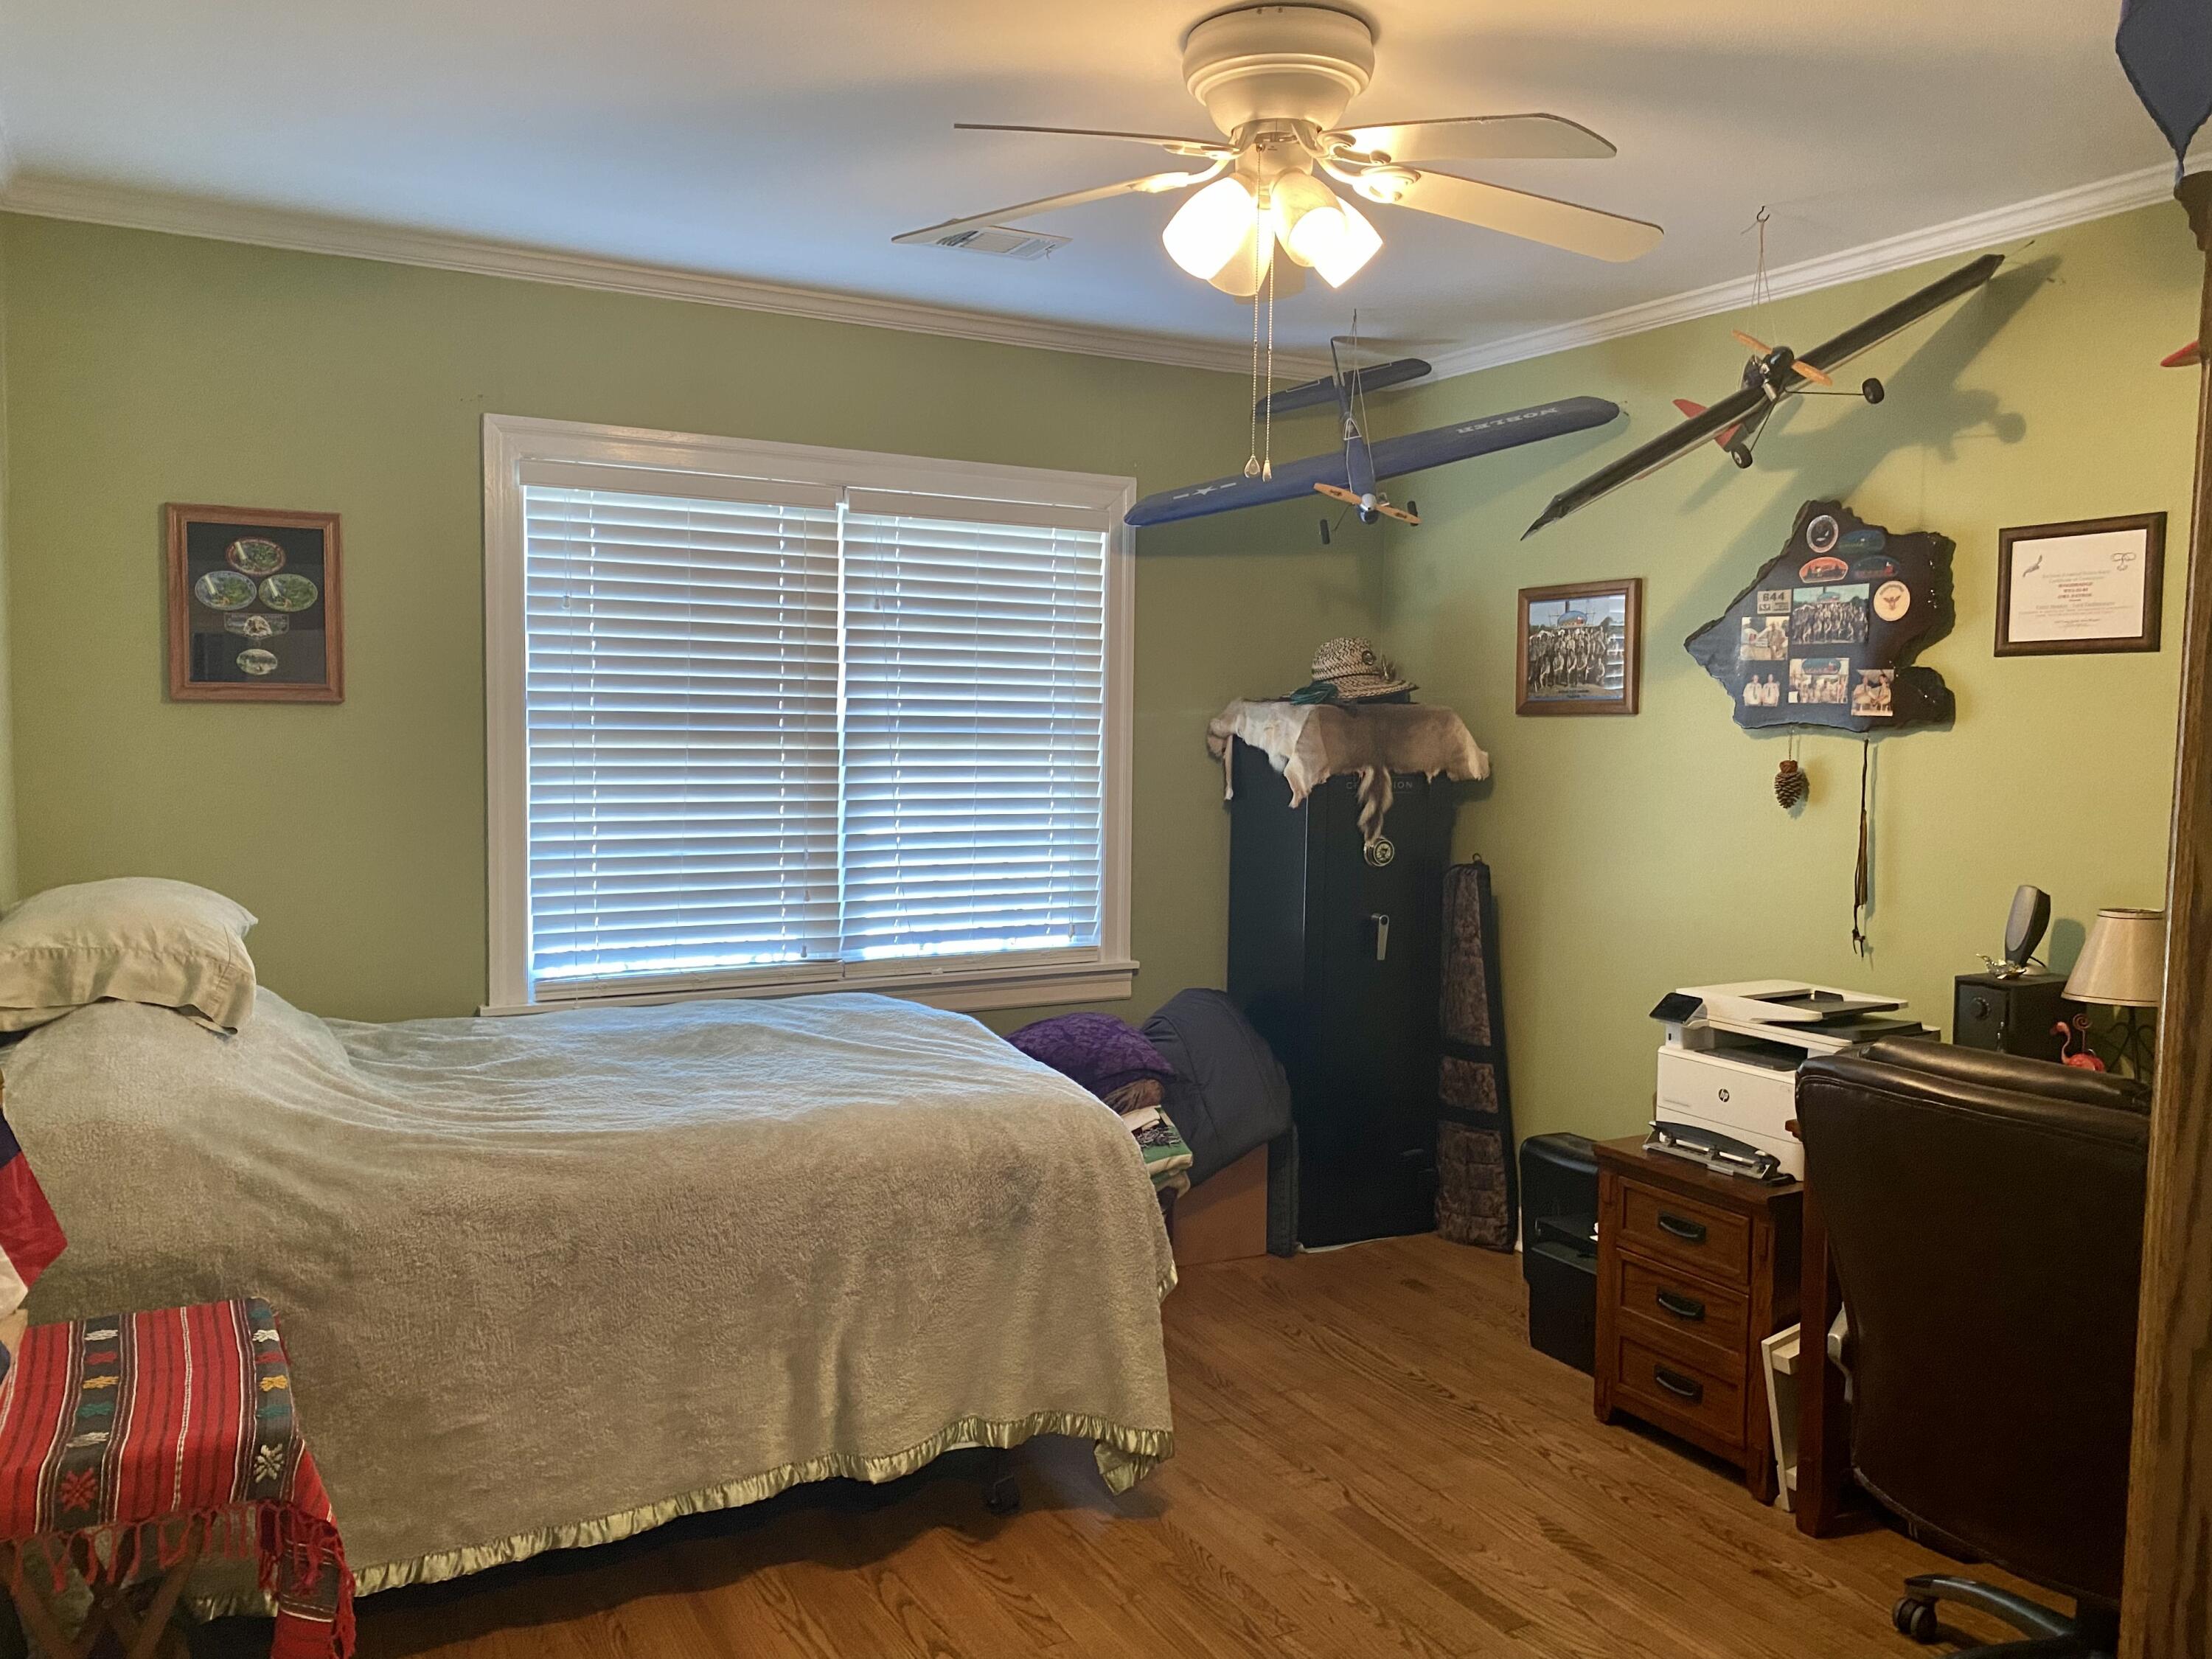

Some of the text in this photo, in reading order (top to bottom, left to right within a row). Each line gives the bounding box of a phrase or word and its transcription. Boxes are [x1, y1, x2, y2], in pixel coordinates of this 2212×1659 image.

[1456, 407, 1558, 434] NOBLER
[1763, 592, 1784, 602] 644
[1718, 1088, 1730, 1102] hp
